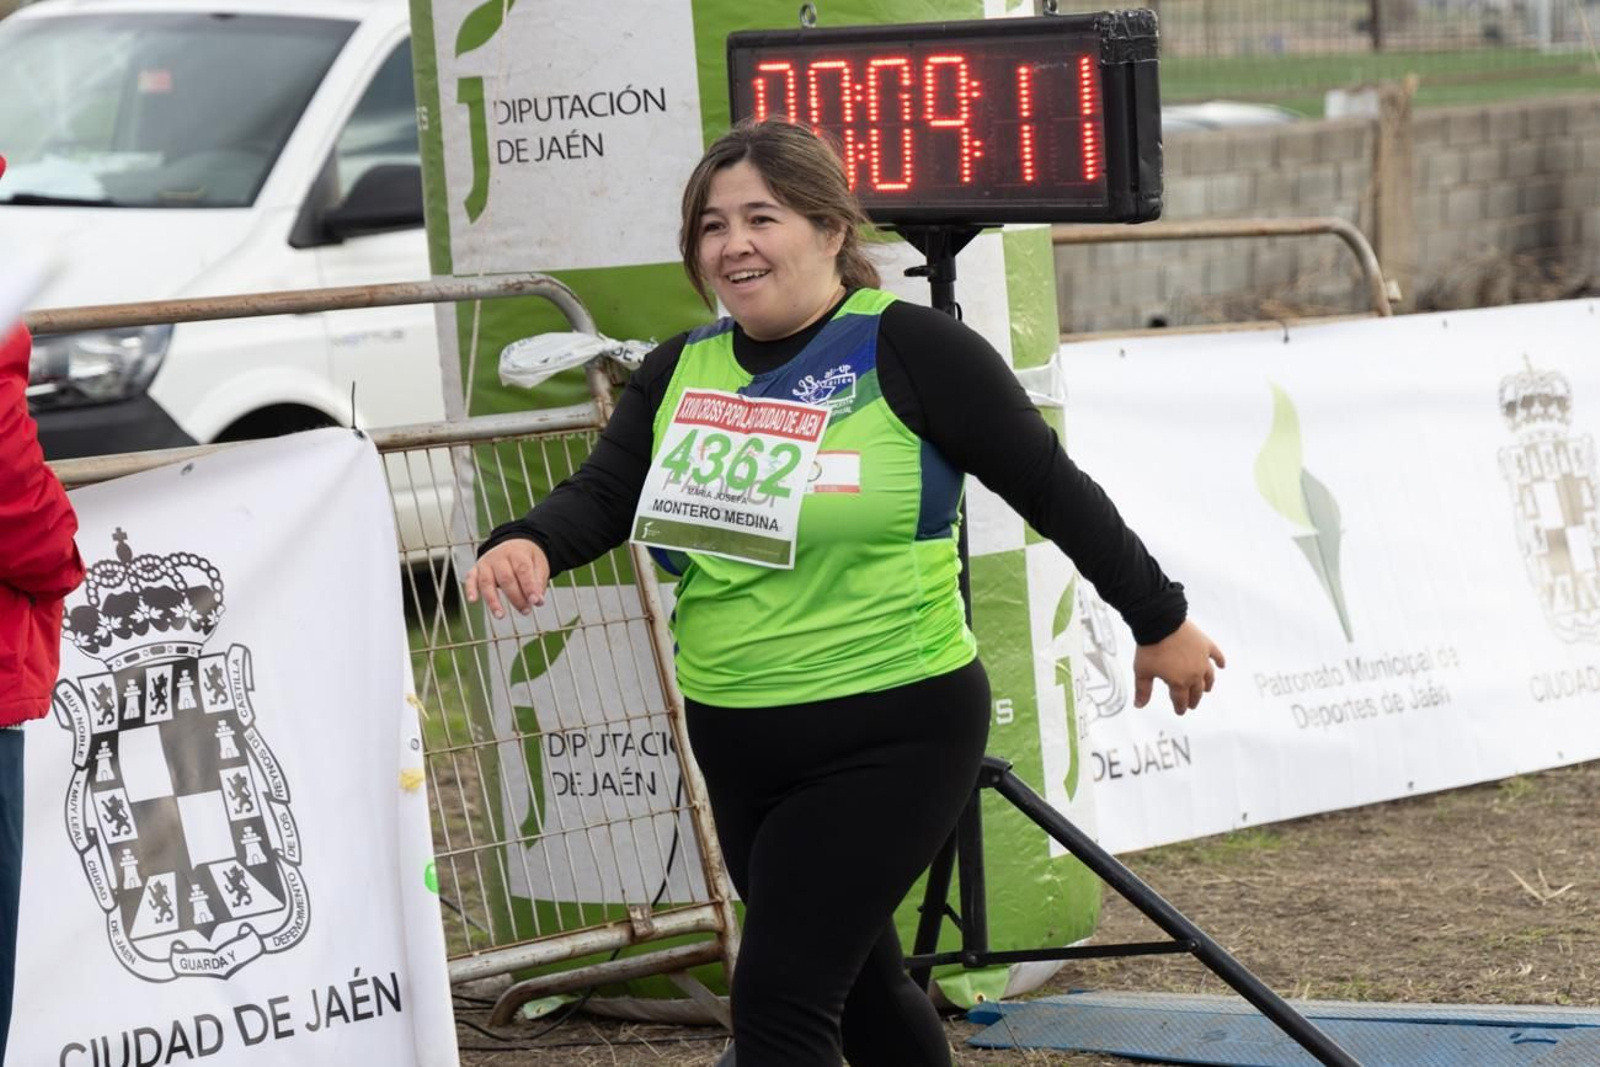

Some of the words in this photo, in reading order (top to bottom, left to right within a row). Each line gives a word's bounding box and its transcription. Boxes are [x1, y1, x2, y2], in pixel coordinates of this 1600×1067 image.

[494, 84, 667, 125] DIPUTACIÓN
[497, 138, 529, 164] DE
[534, 129, 604, 162] JAÉN
[697, 398, 726, 423] CROSS
[782, 410, 800, 433] DE
[661, 428, 801, 498] 4362
[652, 499, 721, 521] MONTERO
[724, 510, 780, 532] MEDINA
[232, 658, 248, 719] CASTILLA
[1253, 663, 1345, 698] Patronato
[1345, 649, 1435, 684] Municipal
[62, 690, 81, 713] MUY
[1290, 696, 1379, 730] Deportes
[1380, 689, 1404, 715] de
[1409, 678, 1452, 711] Jaén
[246, 732, 261, 750] DE
[548, 731, 679, 757] DIPUTACI
[1130, 730, 1192, 776] JAÉN
[588, 767, 657, 797] JAÉN
[70, 788, 79, 815] MUY
[70, 815, 83, 845] LEAL
[279, 811, 294, 840] LOS
[286, 840, 296, 858] DE
[87, 860, 108, 901] CIUDAD
[111, 920, 120, 939] DE
[180, 956, 229, 971] GUARDA
[227, 950, 237, 962] Y
[59, 1012, 224, 1067] CIUDAD
[233, 995, 295, 1047] DE
[305, 967, 403, 1032] JAÉN
